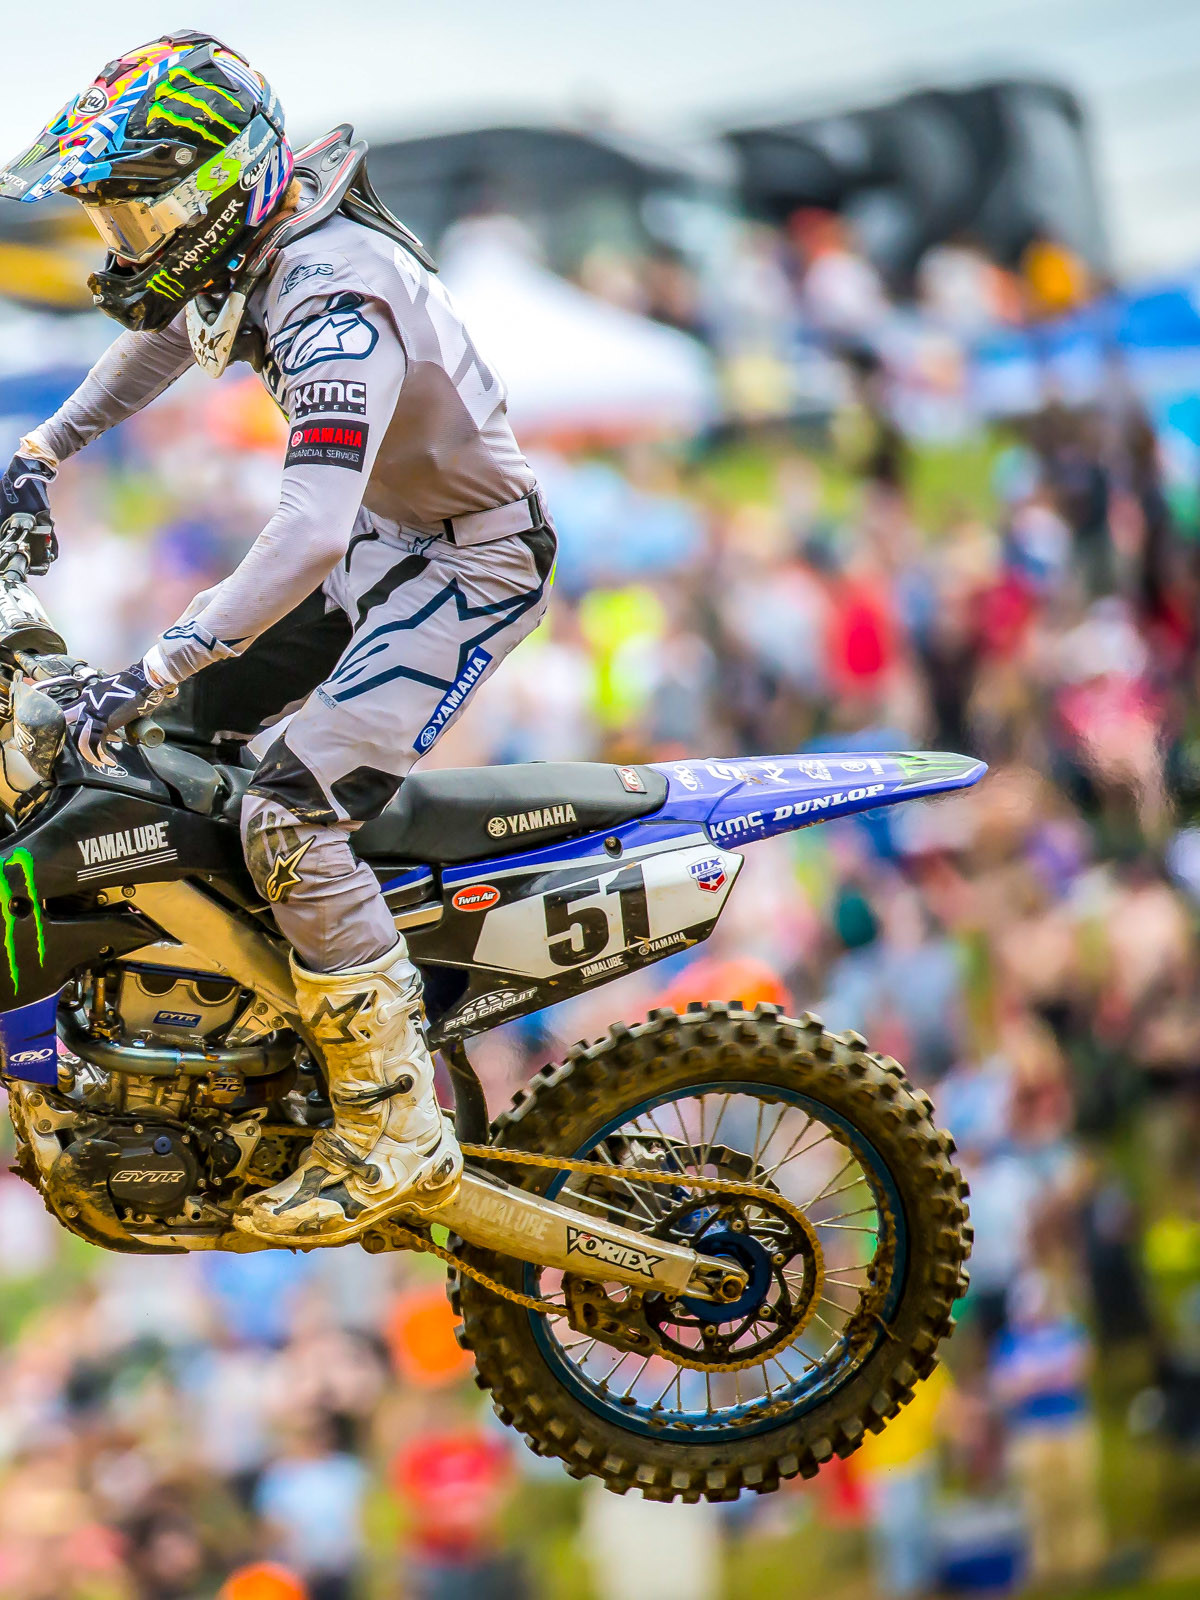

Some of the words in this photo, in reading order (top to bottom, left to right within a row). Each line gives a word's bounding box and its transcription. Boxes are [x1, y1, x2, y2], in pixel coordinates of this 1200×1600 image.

[172, 199, 244, 275] MONSTER
[194, 219, 241, 272] ENERGY
[303, 427, 362, 447] YAMAHA
[326, 449, 360, 462] SERVICES
[432, 656, 488, 726] YAMAHA
[507, 803, 577, 834] YAMAHA
[773, 784, 885, 821] DUNLOP
[78, 821, 169, 865] YAMALUBE
[457, 894, 480, 906] Twin
[481, 891, 496, 901] Air
[543, 864, 650, 966] 51
[649, 932, 687, 952] YAMAHA
[580, 954, 624, 978] YAMALUBE
[444, 1013, 477, 1032] PRO
[479, 987, 538, 1018] CIRCUIT
[111, 1170, 186, 1183] GYTR
[568, 1228, 660, 1275] VORTEX
